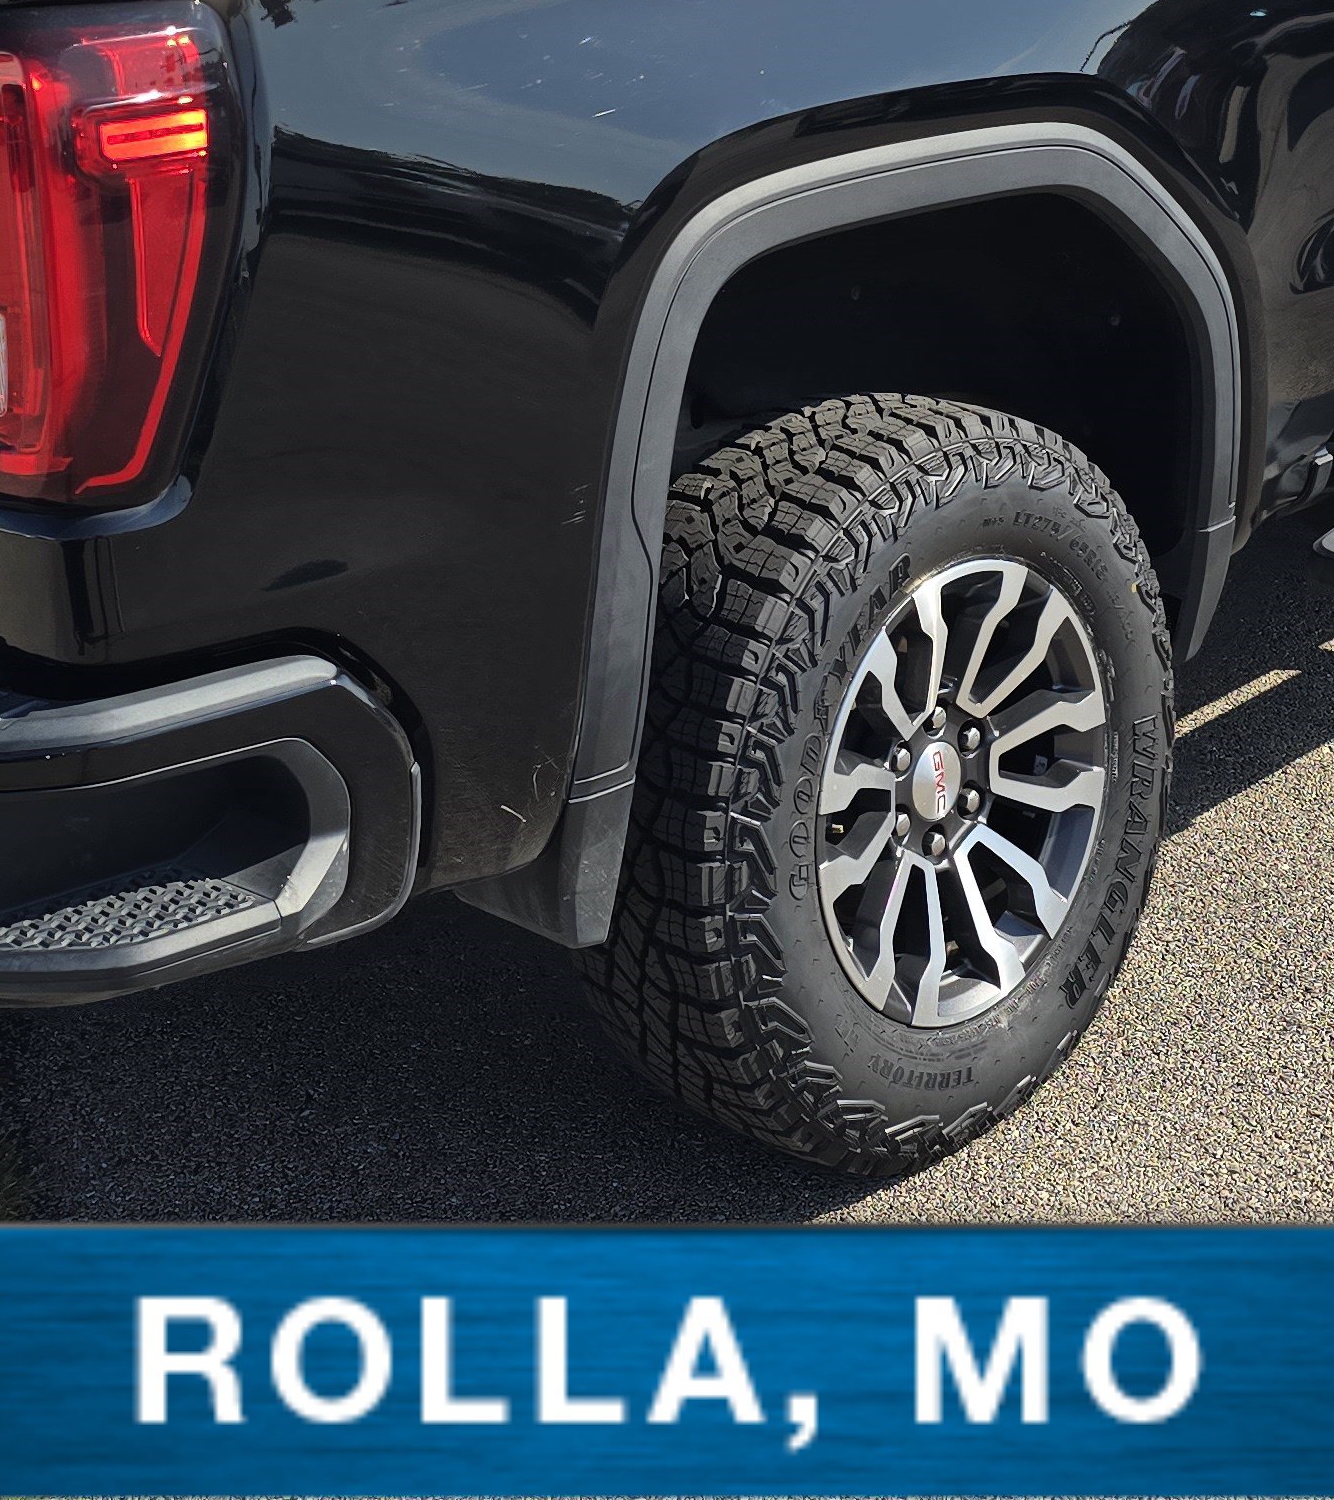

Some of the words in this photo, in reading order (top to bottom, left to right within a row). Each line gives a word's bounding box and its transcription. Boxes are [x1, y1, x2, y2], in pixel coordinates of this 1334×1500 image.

[932, 749, 947, 815] GMC
[1058, 714, 1157, 1009] WRANGLER
[867, 1053, 975, 1092] TERRITORY
